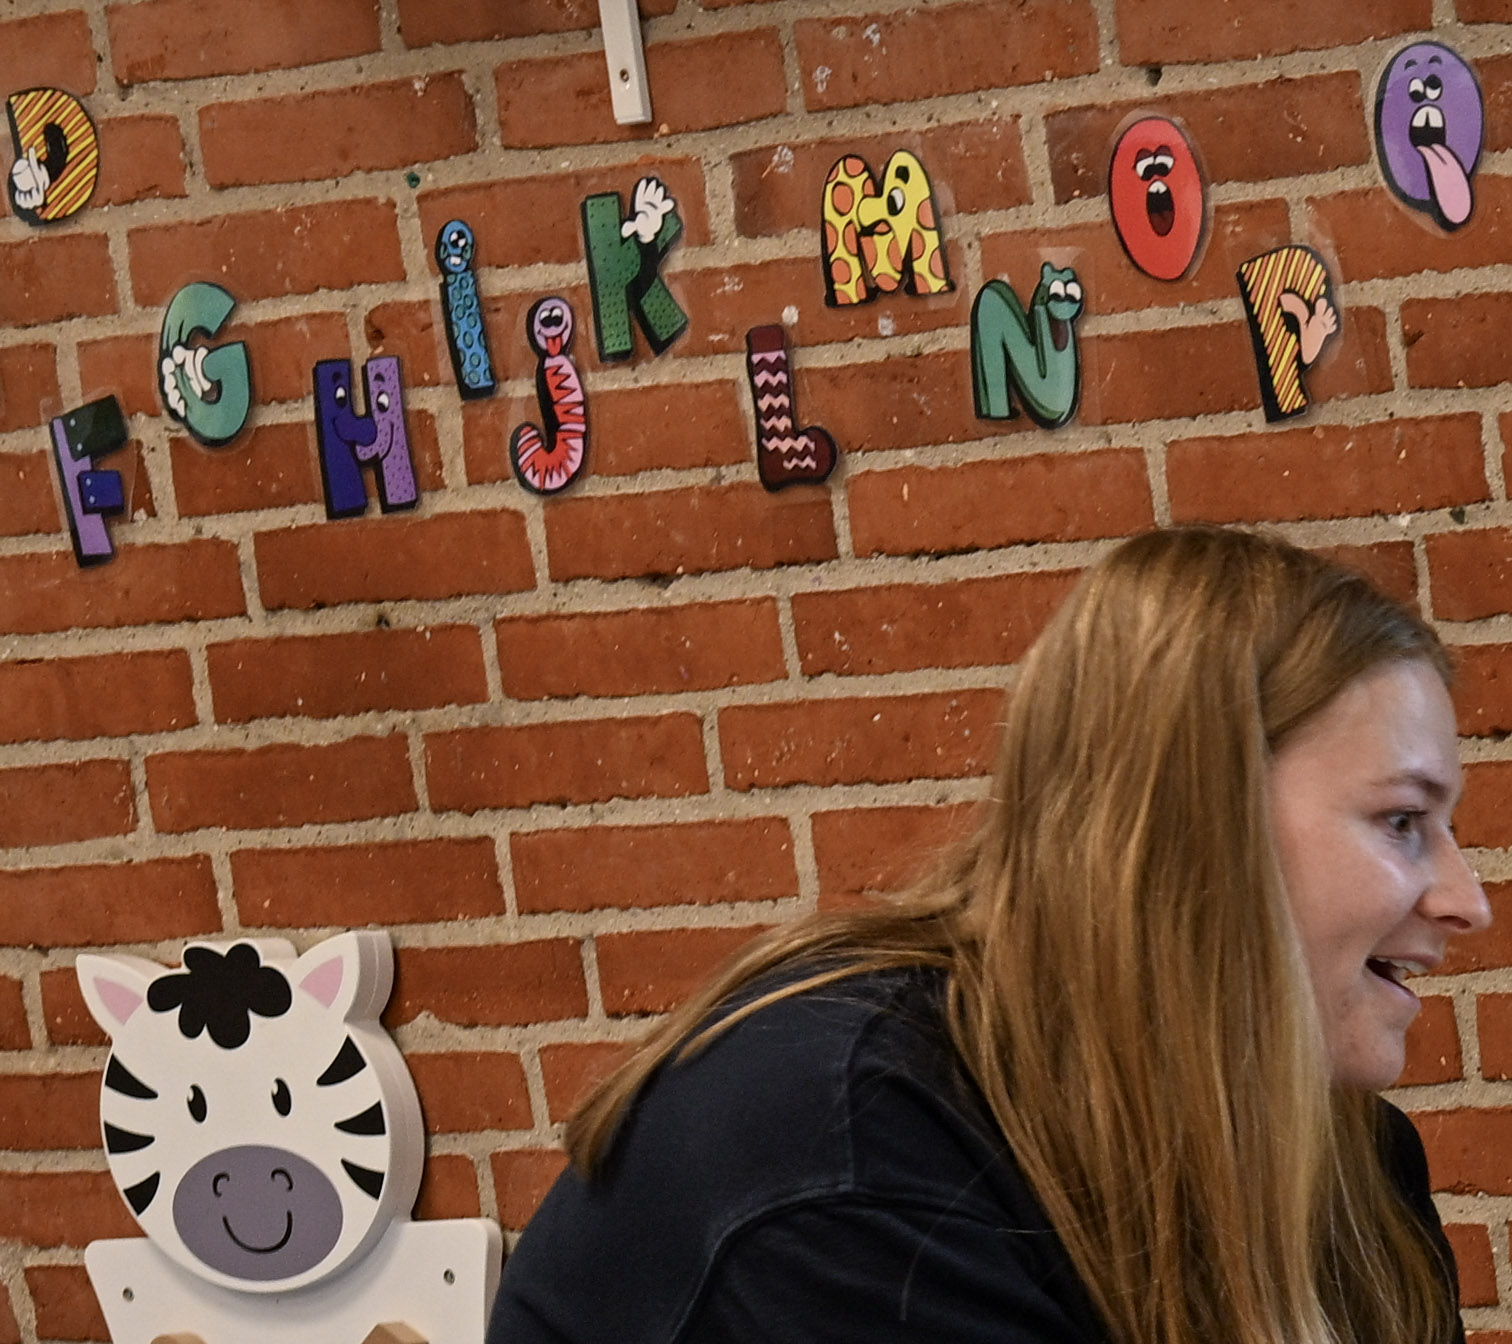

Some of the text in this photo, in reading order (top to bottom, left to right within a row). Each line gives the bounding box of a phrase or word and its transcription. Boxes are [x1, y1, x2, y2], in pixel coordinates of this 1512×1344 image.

[8, 87, 98, 226] D
[1109, 117, 1204, 280] O
[1375, 41, 1484, 232] Q
[581, 177, 688, 362] K
[822, 149, 955, 308] M
[159, 277, 251, 446] G
[510, 296, 586, 494] J
[746, 324, 838, 492] L
[971, 262, 1083, 429] N
[1237, 244, 1338, 423] P
[50, 395, 128, 568] F
[313, 355, 417, 519] H
